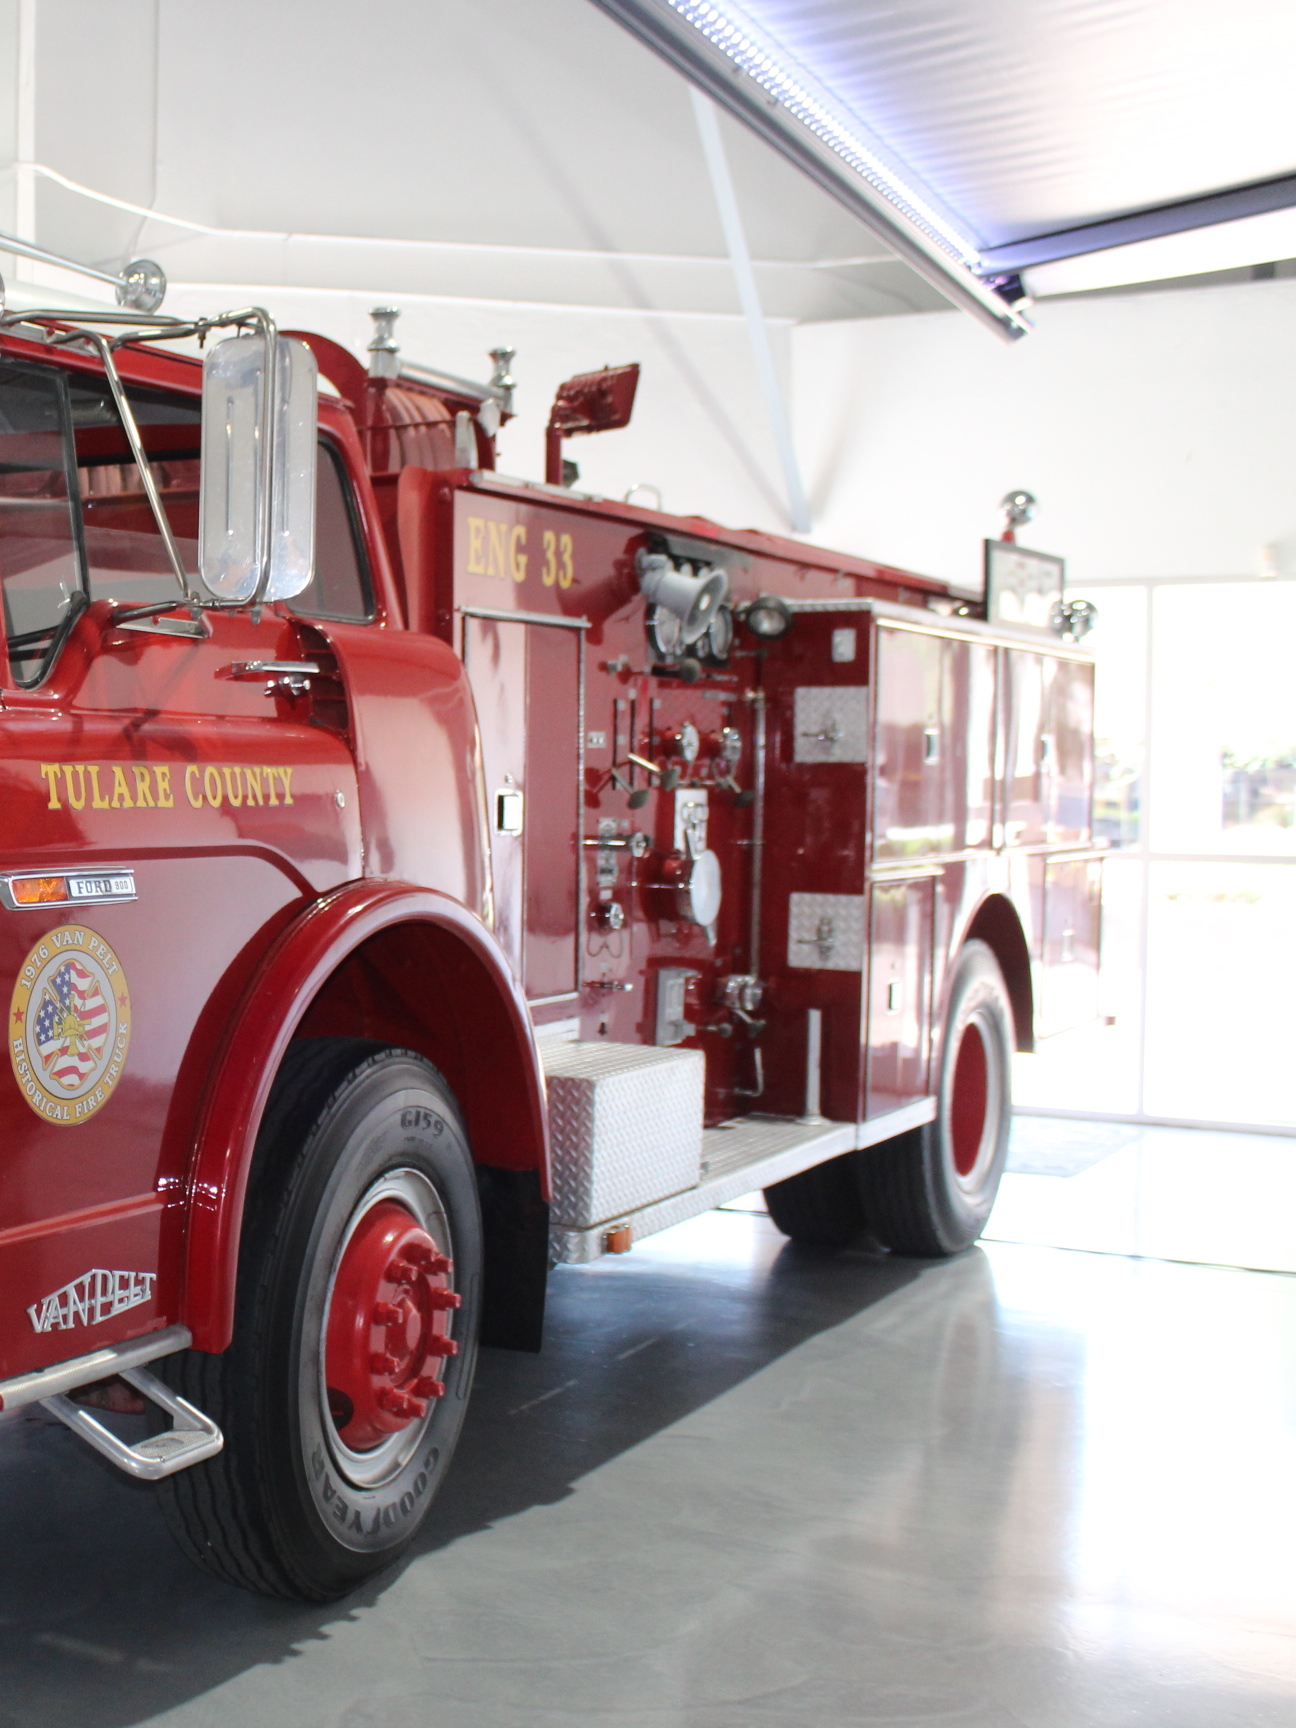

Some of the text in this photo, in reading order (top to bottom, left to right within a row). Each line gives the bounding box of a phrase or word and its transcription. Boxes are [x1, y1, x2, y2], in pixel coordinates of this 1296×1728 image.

[466, 516, 574, 589] ENG 33
[40, 763, 295, 810] TULARE COUNTY
[76, 880, 112, 895] FORD
[21, 930, 119, 989] 1976 VAN PELT
[12, 1021, 128, 1120] HISTORICAL FIRE TRUCK
[311, 1443, 440, 1535] GOODYEAR
